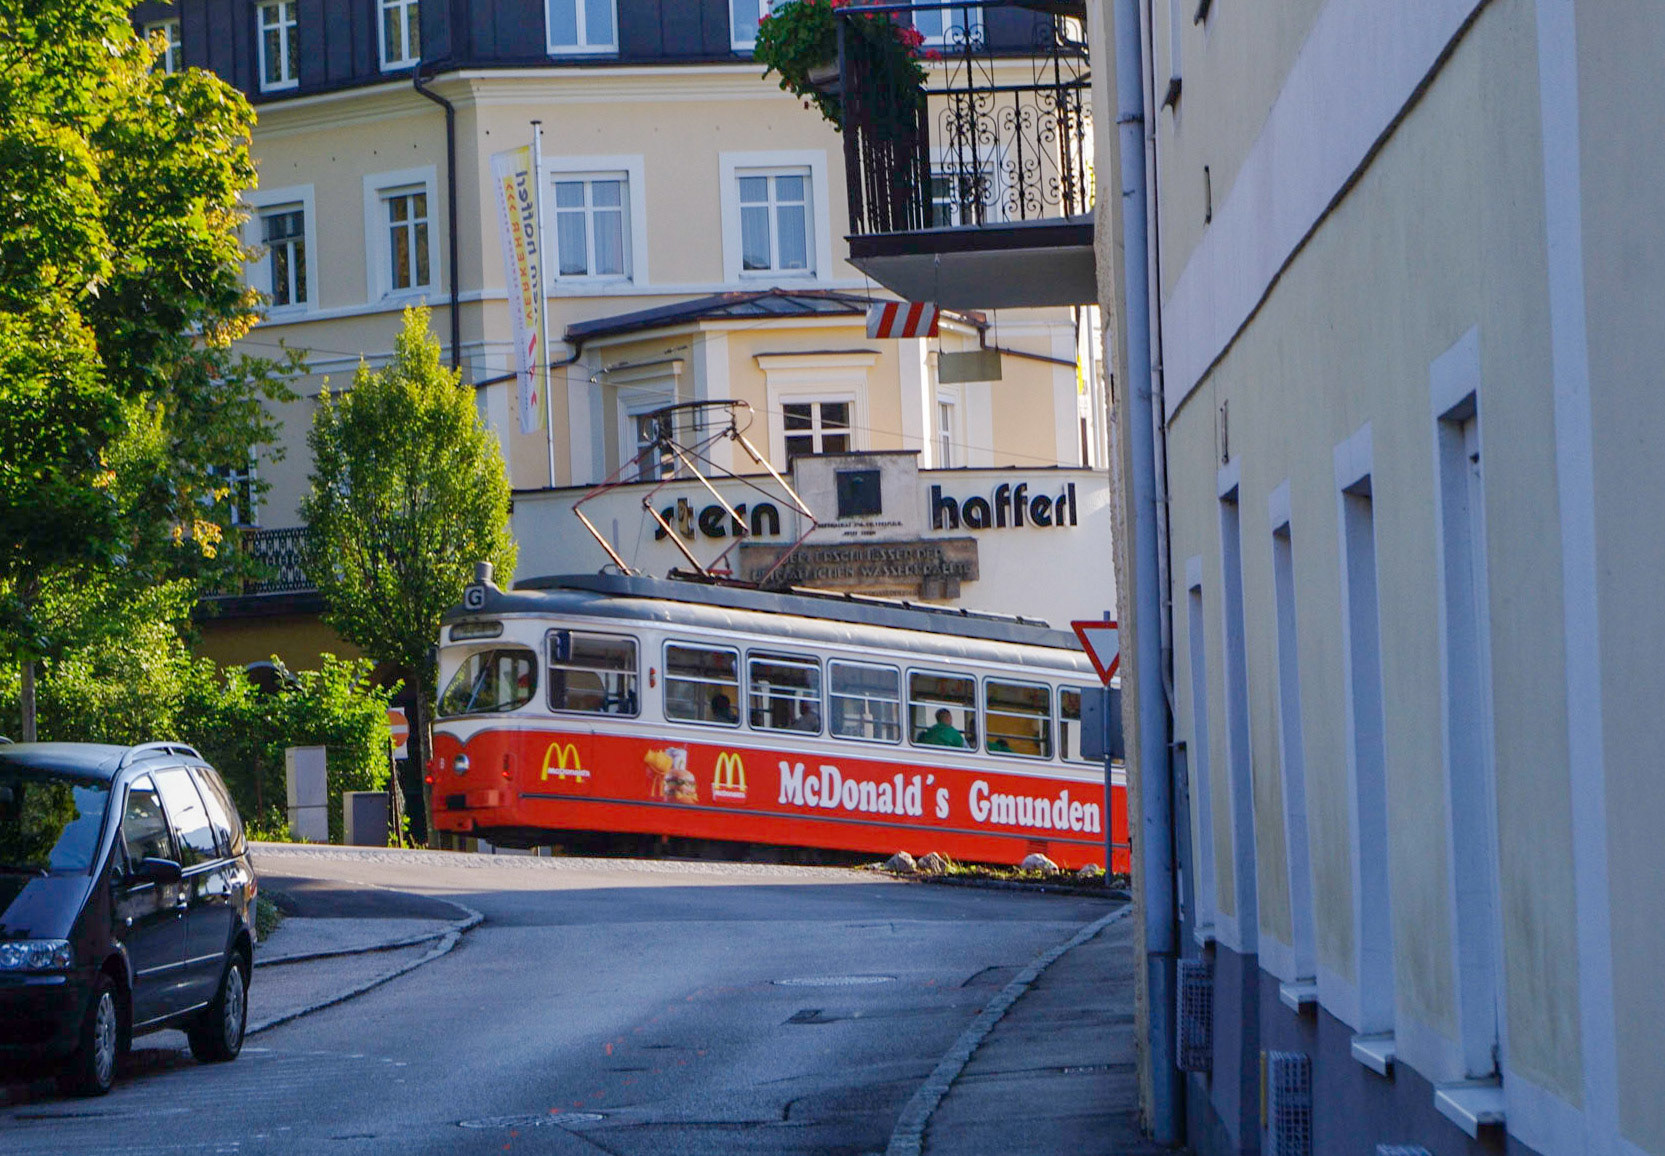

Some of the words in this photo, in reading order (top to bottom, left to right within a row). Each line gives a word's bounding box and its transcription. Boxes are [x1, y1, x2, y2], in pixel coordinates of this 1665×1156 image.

[654, 497, 780, 540] stern
[929, 482, 1078, 529] hafferl
[468, 589, 483, 606] G
[968, 779, 1101, 833] Gmunden
